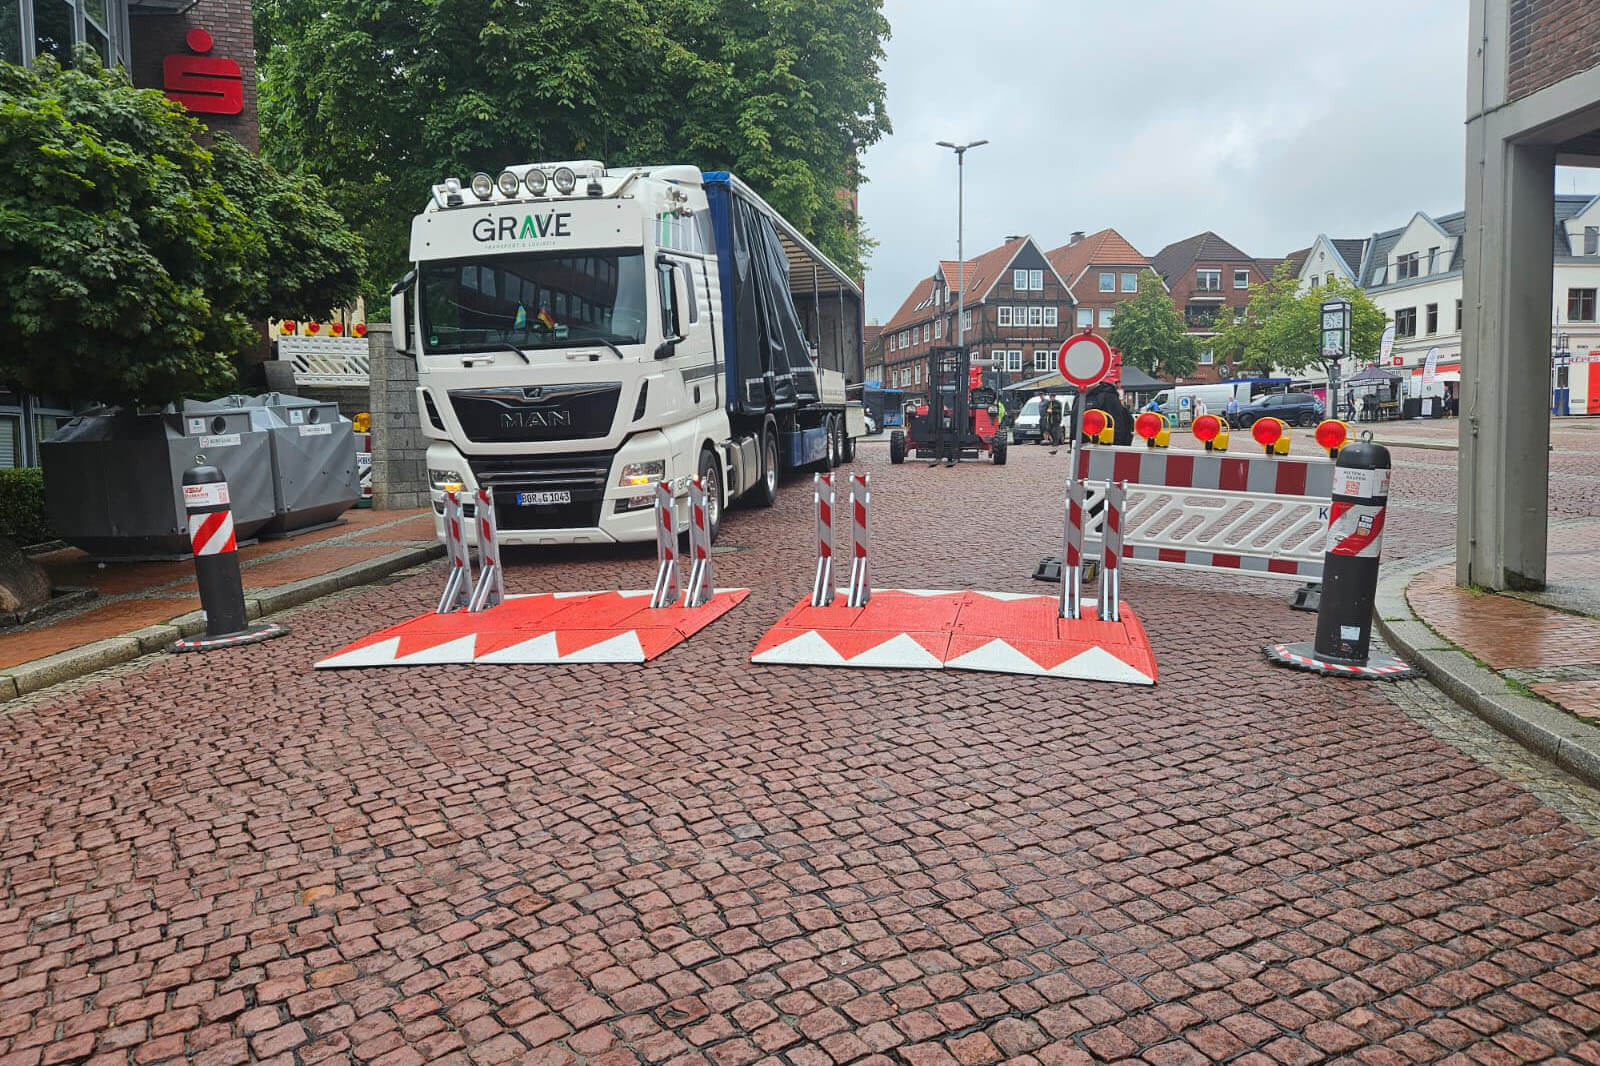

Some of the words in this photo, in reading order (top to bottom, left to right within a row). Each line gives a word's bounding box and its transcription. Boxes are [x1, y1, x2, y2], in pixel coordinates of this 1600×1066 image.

[473, 213, 571, 242] GRAVE
[499, 411, 571, 428] MAN
[522, 493, 537, 503] BOR
[550, 491, 569, 501] 1043
